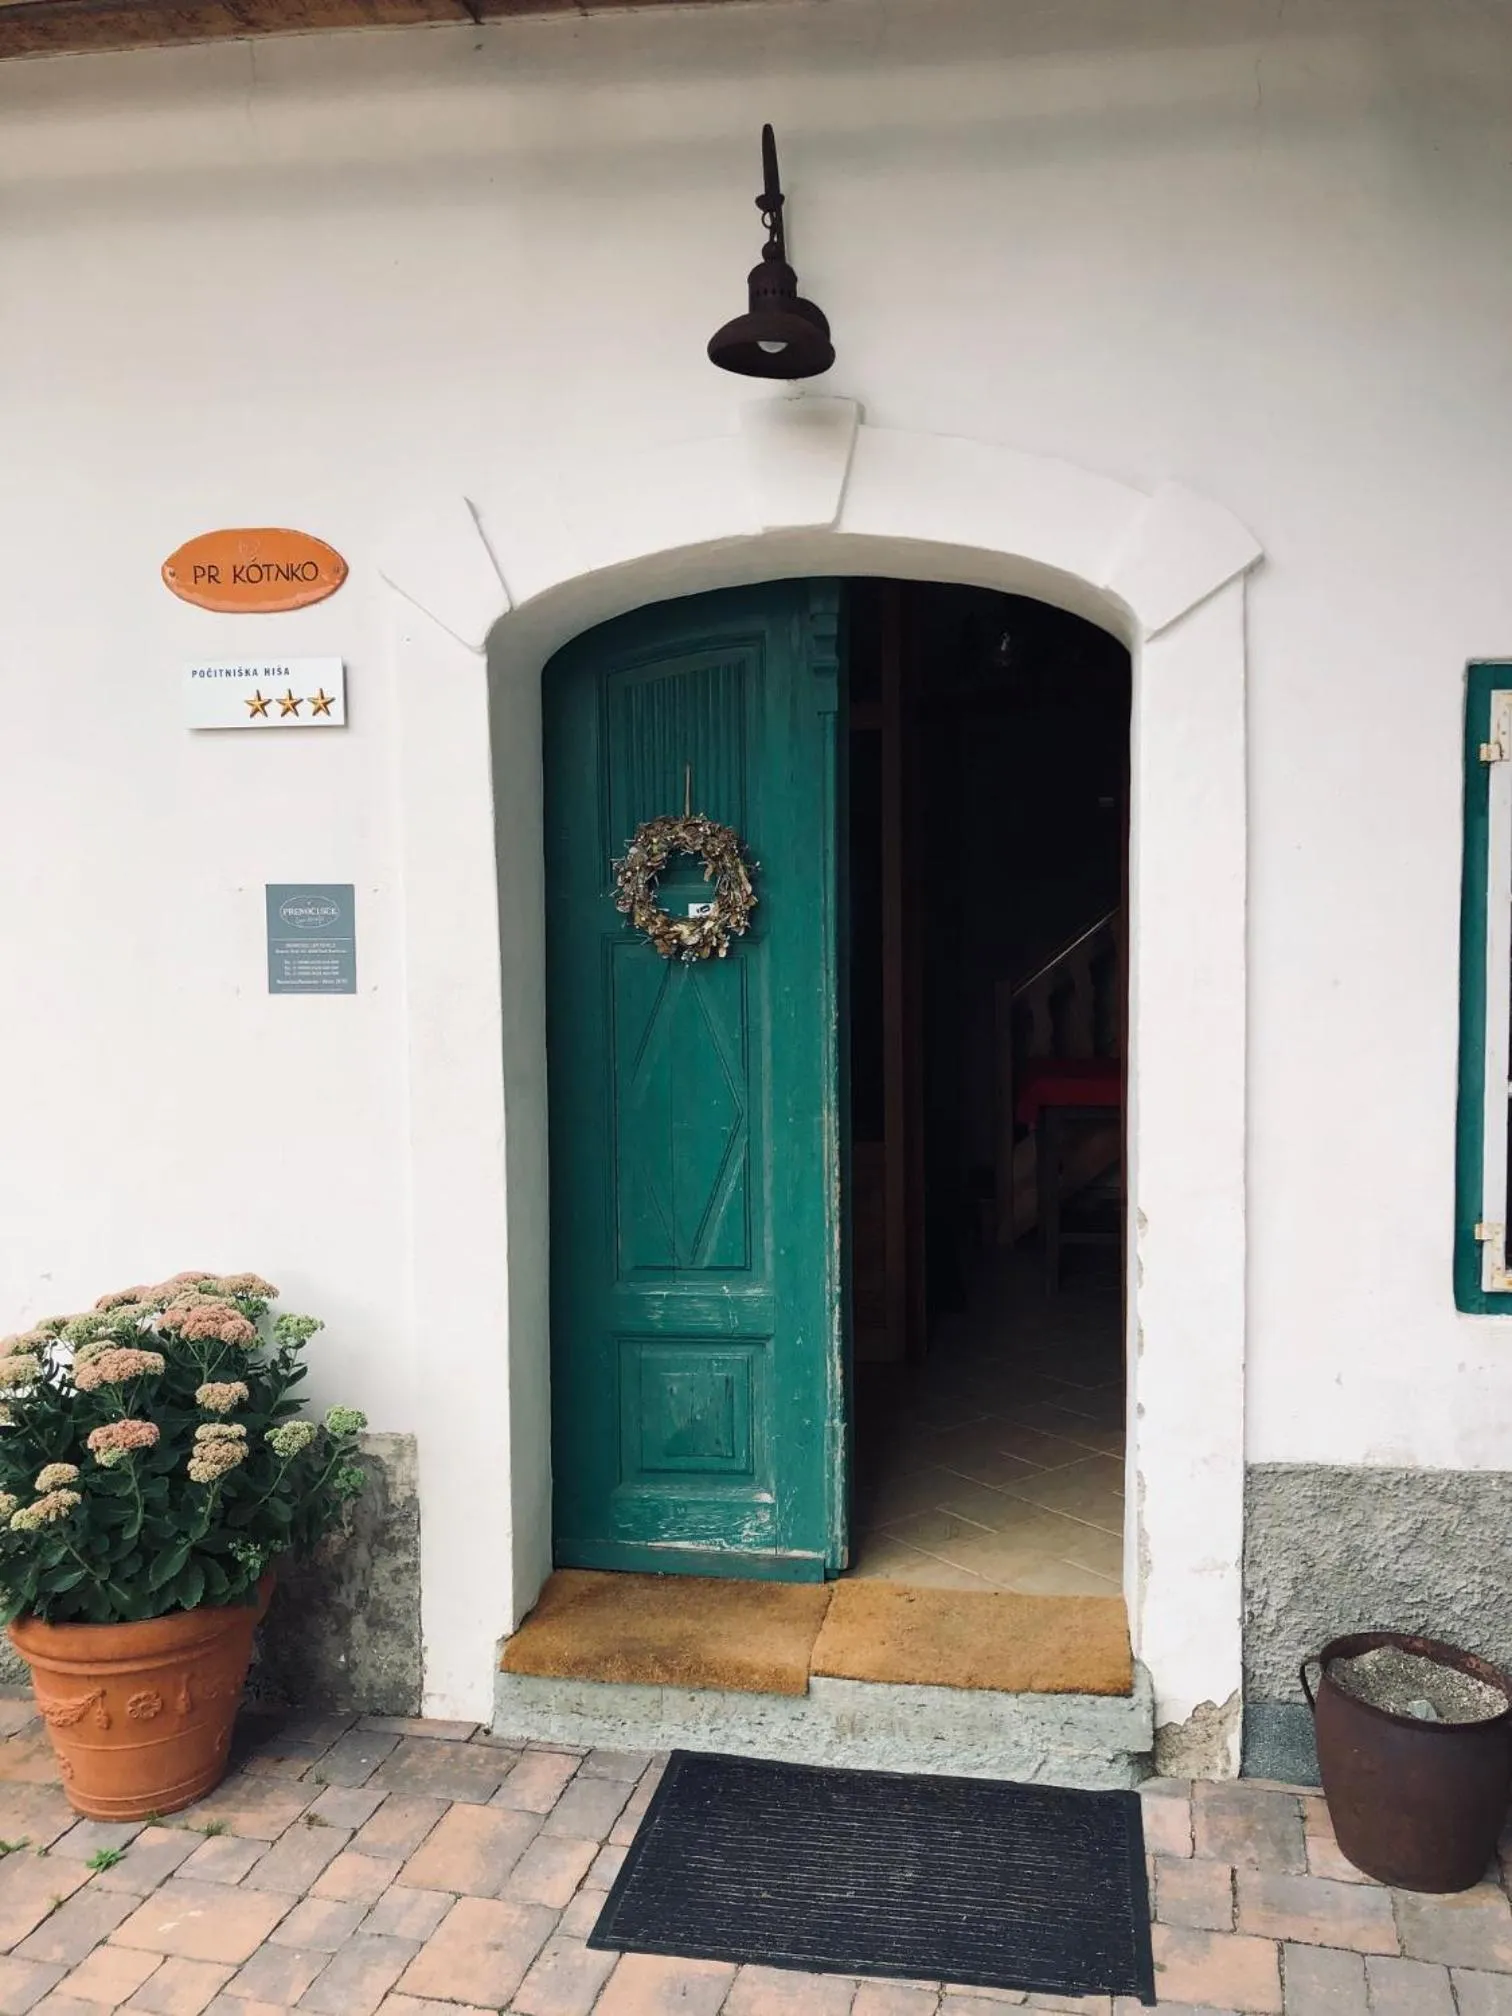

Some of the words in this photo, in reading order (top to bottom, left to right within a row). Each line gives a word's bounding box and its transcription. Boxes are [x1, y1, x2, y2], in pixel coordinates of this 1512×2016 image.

[192, 565, 222, 585] PR
[232, 557, 320, 584] KÓTNKO
[191, 665, 259, 679] POČITNIŠKA
[263, 664, 291, 677] HIŠA
